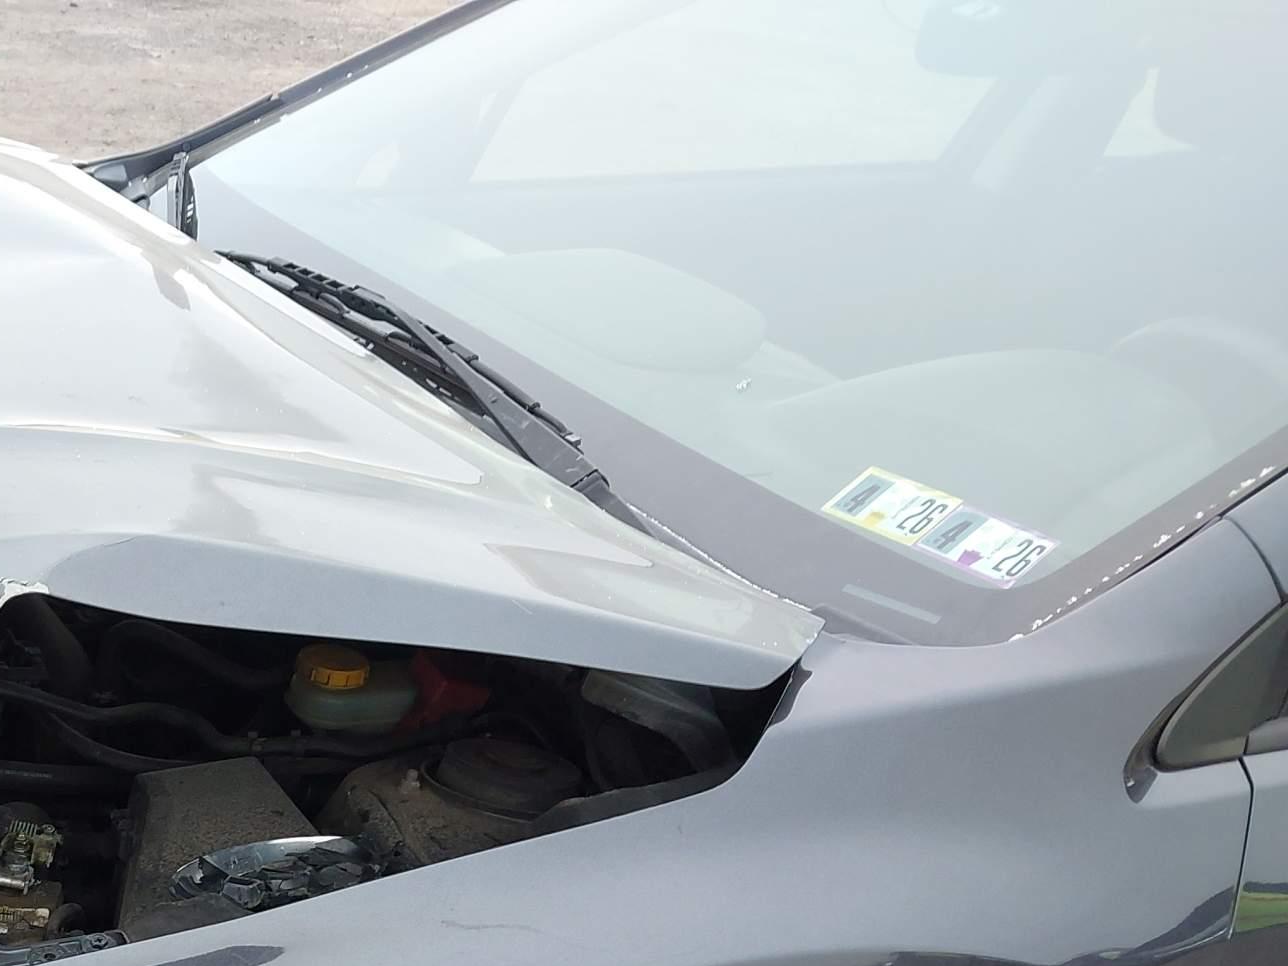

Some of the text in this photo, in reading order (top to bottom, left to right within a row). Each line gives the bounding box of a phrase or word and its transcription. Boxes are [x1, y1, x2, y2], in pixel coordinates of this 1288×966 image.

[844, 483, 949, 536] 4 26
[935, 520, 1046, 577] 4 26
